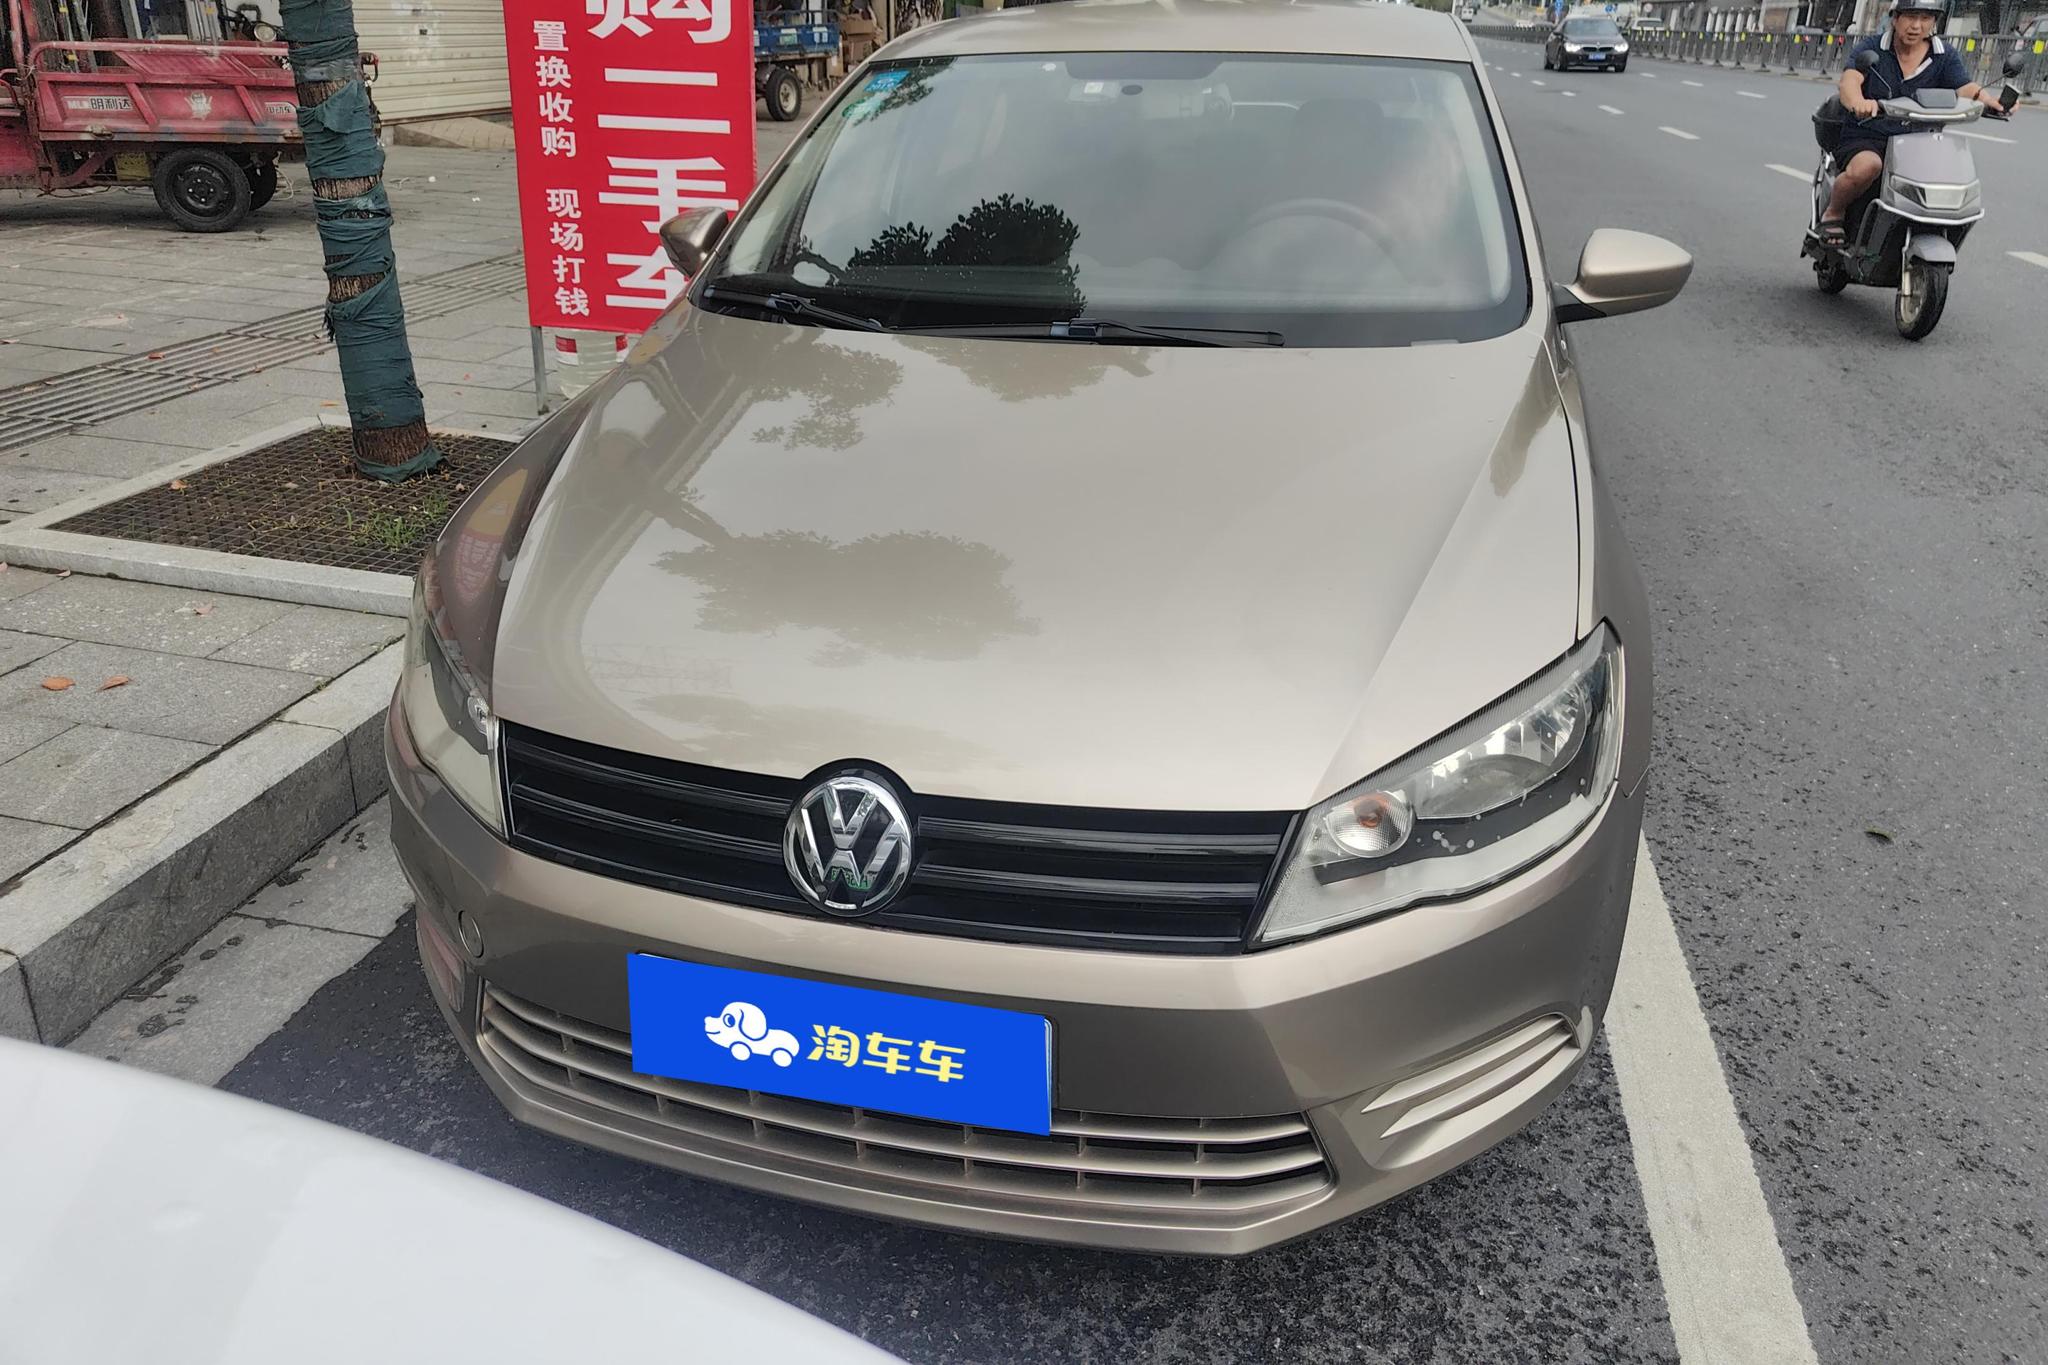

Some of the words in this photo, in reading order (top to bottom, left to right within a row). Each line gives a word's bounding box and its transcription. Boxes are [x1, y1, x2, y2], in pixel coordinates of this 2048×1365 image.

[90, 97, 131, 111] 明利达
[533, 20, 577, 158] 置换收购
[546, 188, 590, 317] 现场打钱
